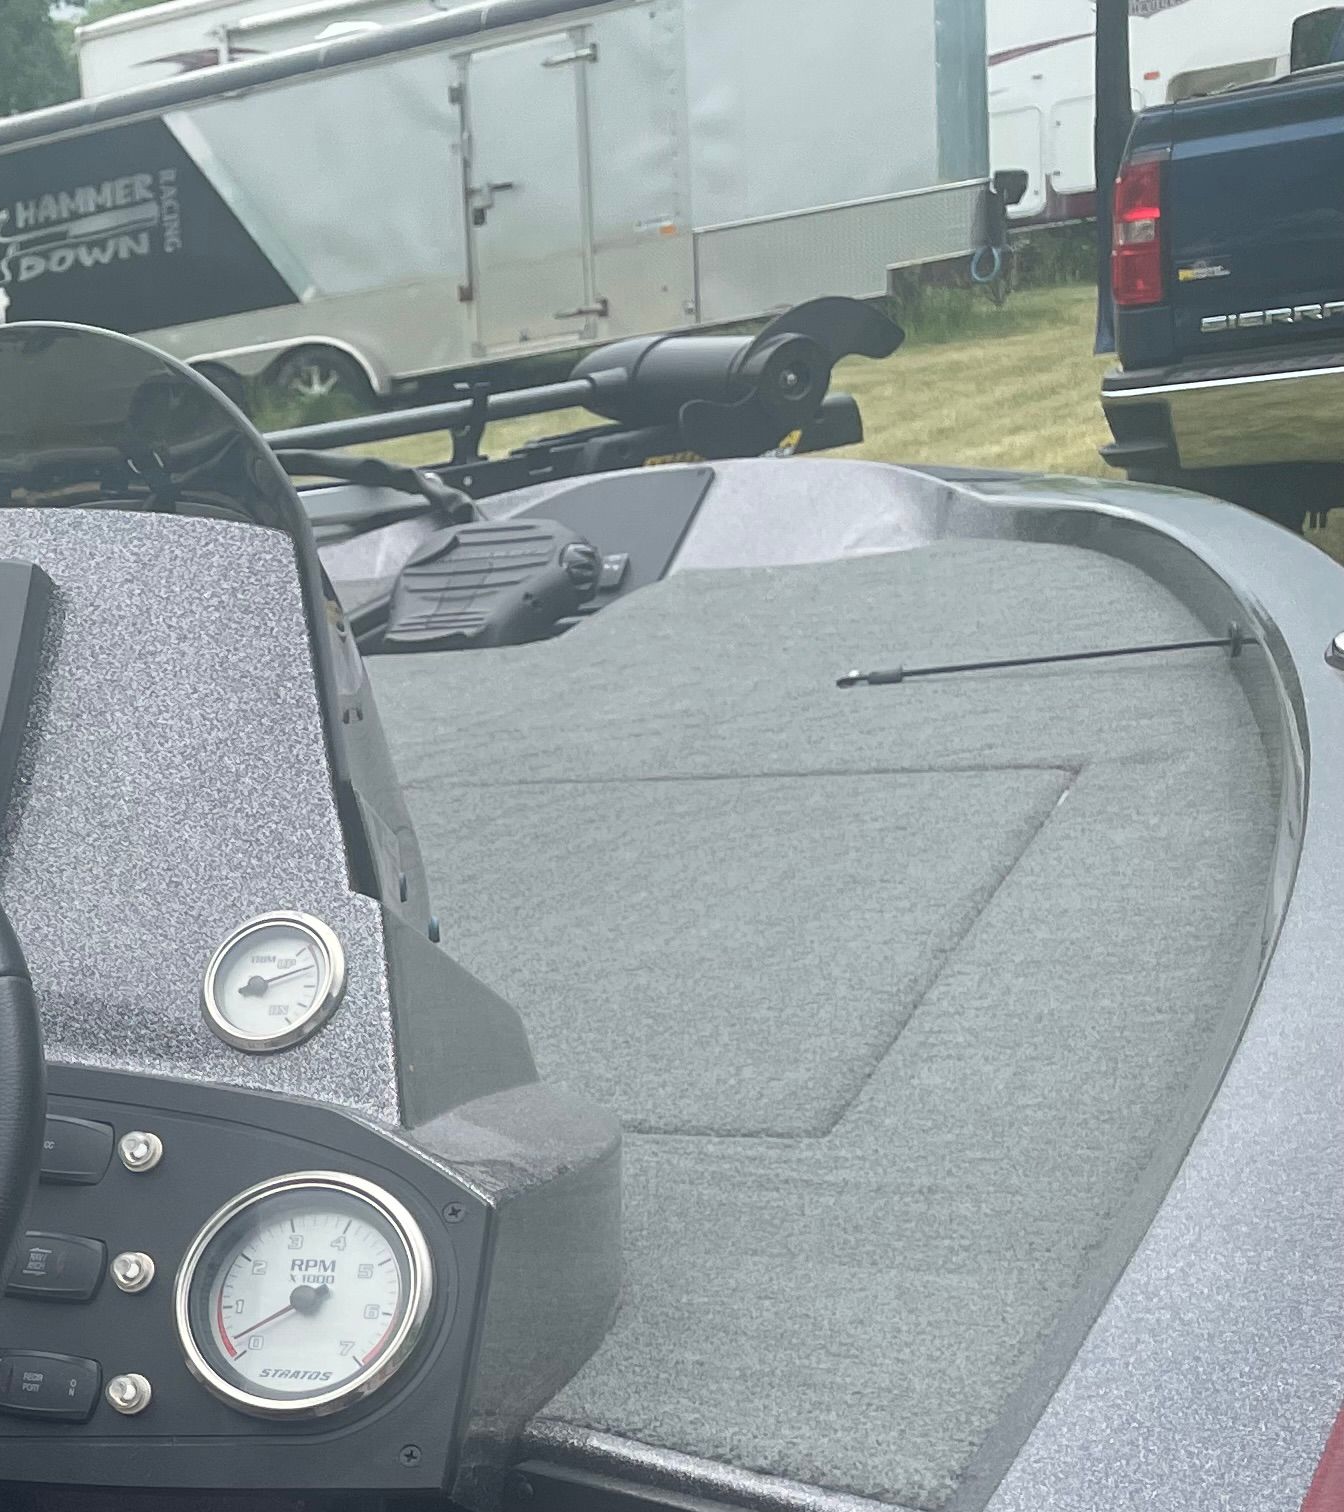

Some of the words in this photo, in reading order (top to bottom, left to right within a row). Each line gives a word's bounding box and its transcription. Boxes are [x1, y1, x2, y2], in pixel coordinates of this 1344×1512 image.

[15, 173, 153, 228] HAMMER
[159, 168, 183, 253] RACING
[17, 232, 150, 282] DOWN
[288, 1234, 304, 1250] 3
[330, 1235, 347, 1251] 4
[252, 1260, 268, 1276] 2
[290, 1258, 336, 1273] RPM
[357, 1264, 374, 1279] 5
[301, 1274, 335, 1285] 1000
[235, 1299, 244, 1314] 1
[363, 1303, 380, 1319] 6
[248, 1336, 264, 1350] 0
[339, 1341, 355, 1356] 7
[258, 1368, 333, 1382] STRATOS
